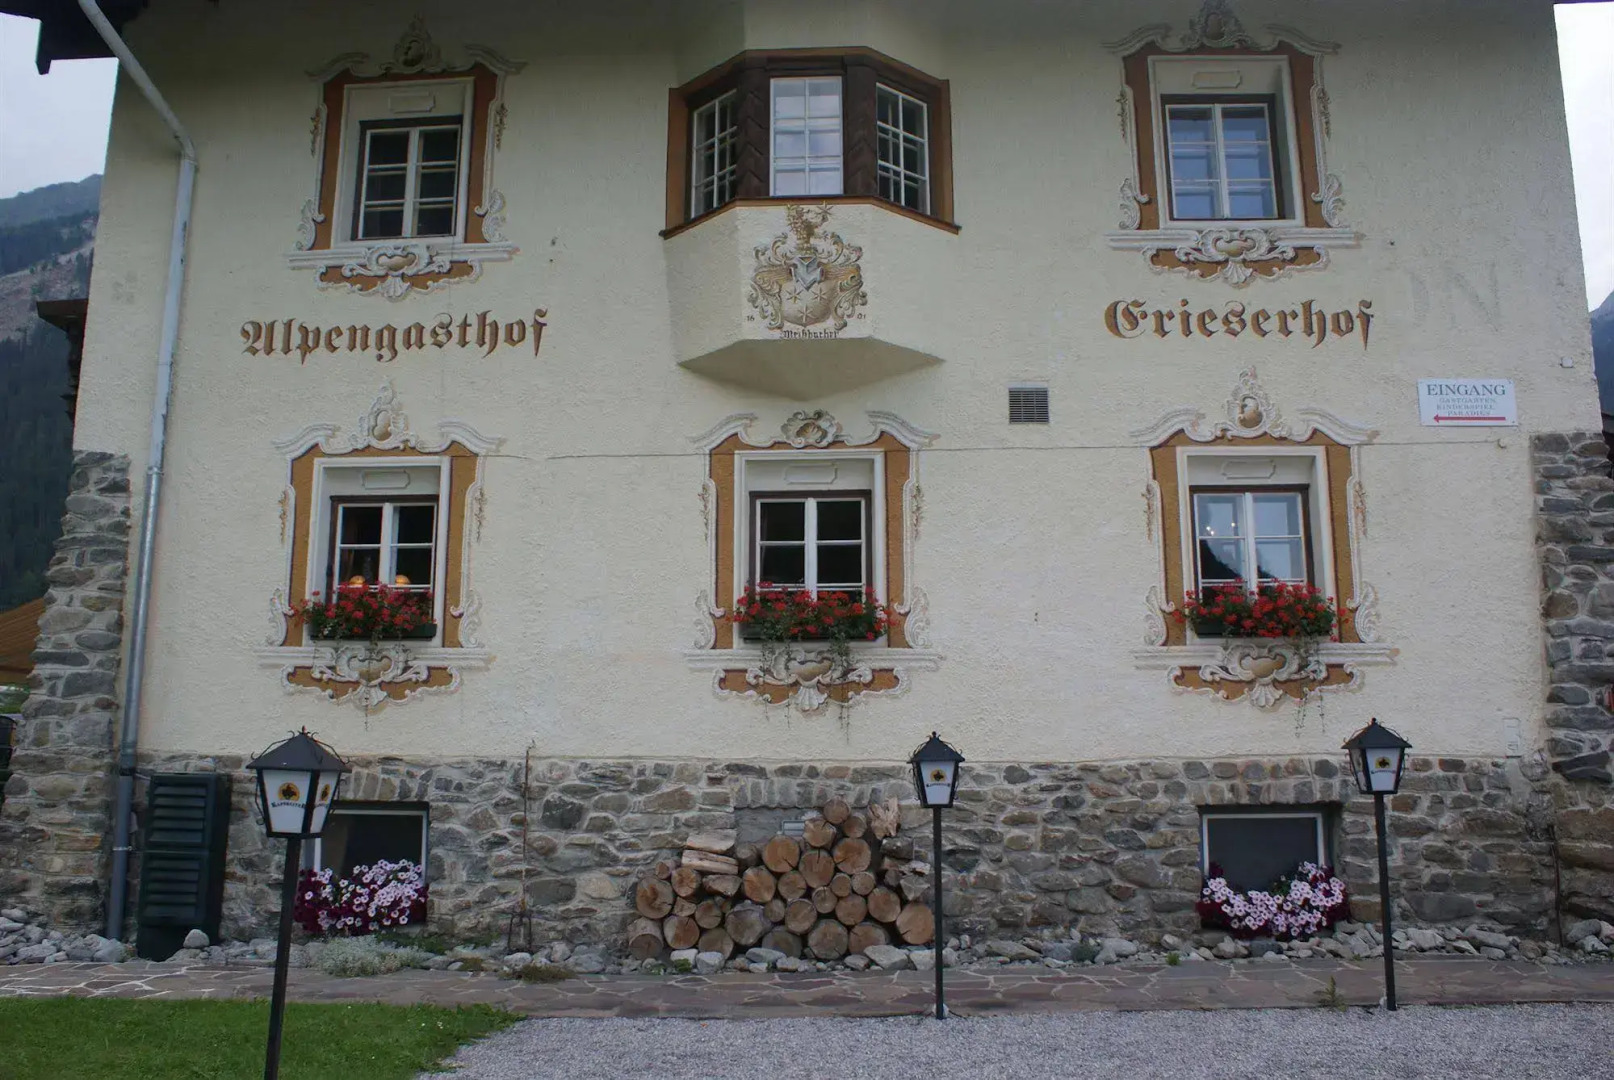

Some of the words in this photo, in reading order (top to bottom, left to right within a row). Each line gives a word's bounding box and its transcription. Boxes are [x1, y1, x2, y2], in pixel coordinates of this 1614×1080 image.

[240, 308, 548, 366] Alpengasthof
[1104, 298, 1375, 351] Grieserhof
[1426, 383, 1506, 396] EINGANG
